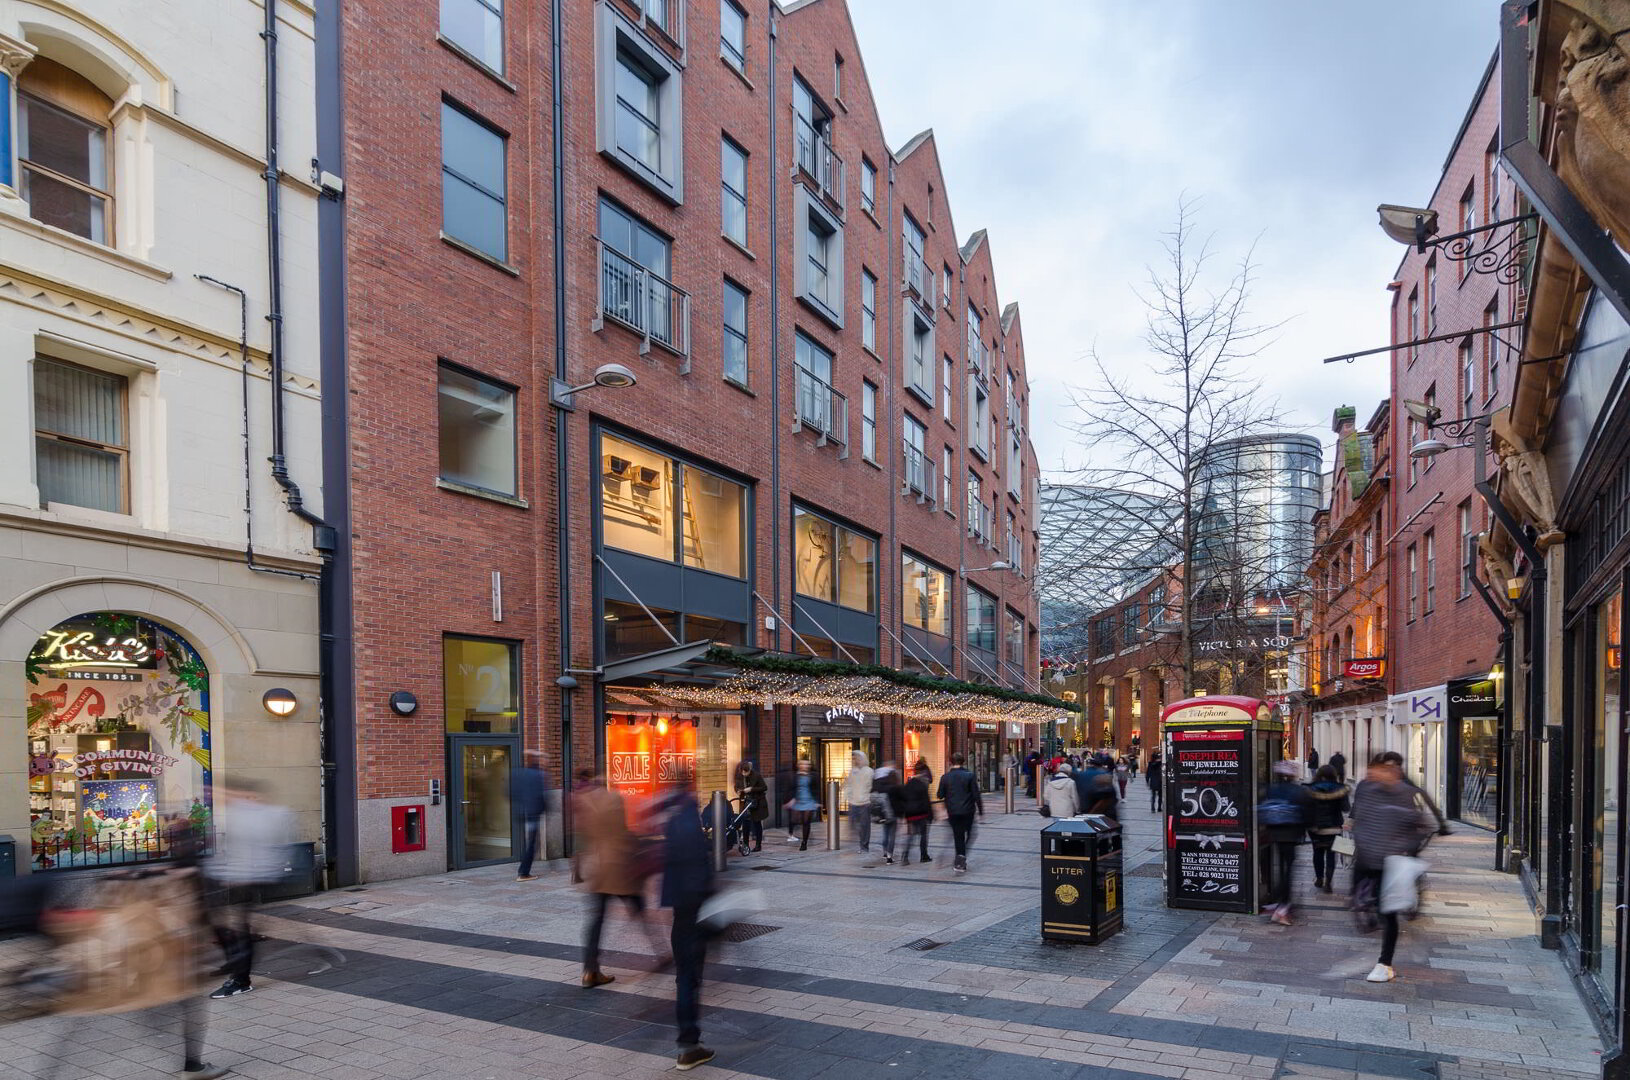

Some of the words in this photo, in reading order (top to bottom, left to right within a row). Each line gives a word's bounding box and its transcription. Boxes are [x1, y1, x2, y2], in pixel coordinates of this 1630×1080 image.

[1350, 662, 1378, 672] Argos
[58, 671, 100, 680] INCE
[105, 673, 135, 681] 1851
[475, 665, 505, 713] 2
[825, 704, 865, 725] FATFACE
[1188, 708, 1229, 718] Telephone
[73, 749, 179, 768] COMMUNITY
[1180, 752, 1214, 762] JOSEPH
[1217, 751, 1238, 761] REA
[74, 764, 98, 778] OF
[100, 761, 163, 777] GIVING
[612, 755, 650, 781] SALE
[658, 755, 694, 781] SALE
[1195, 761, 1239, 770] JEWELLERS
[1180, 786, 1239, 818] 50%
[1051, 866, 1083, 876] LITTER
